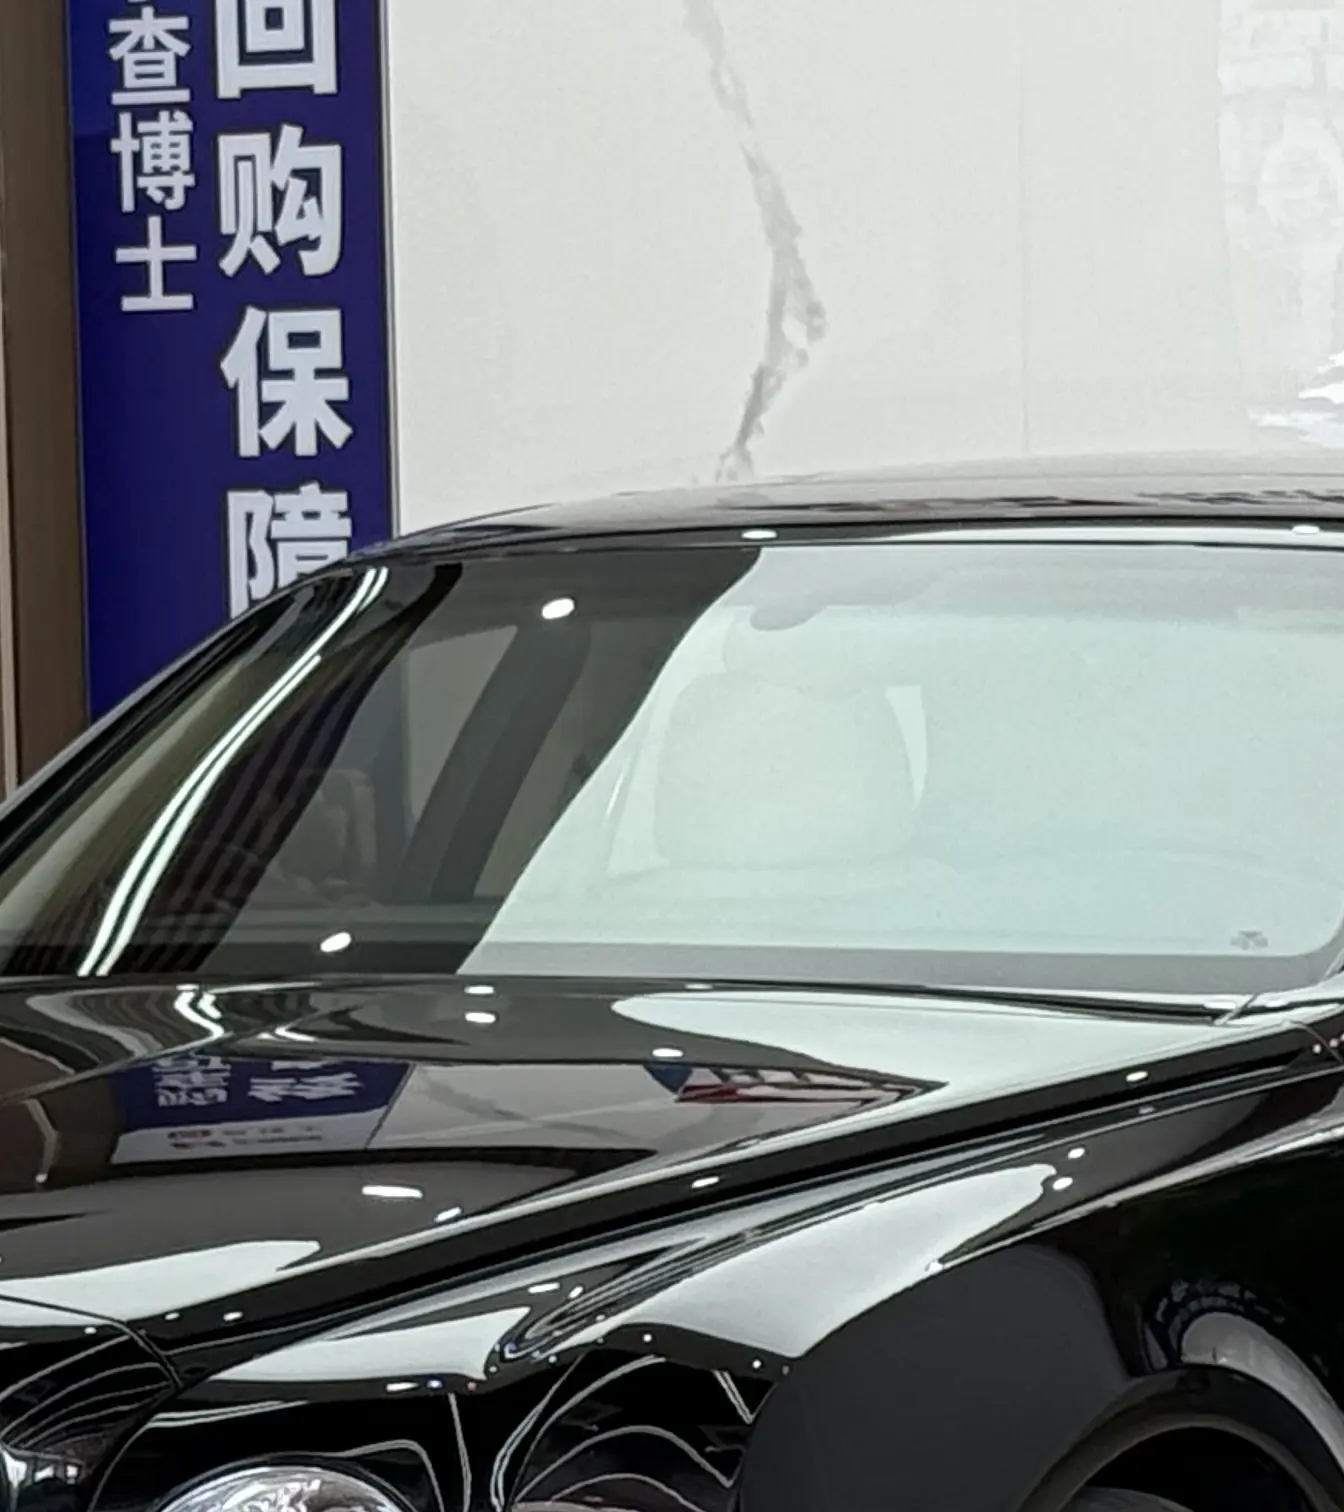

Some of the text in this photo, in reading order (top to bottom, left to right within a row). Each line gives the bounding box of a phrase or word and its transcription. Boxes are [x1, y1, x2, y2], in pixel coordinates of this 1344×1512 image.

[108, 6, 197, 312] 查博士
[215, 0, 353, 618] 回购保障
